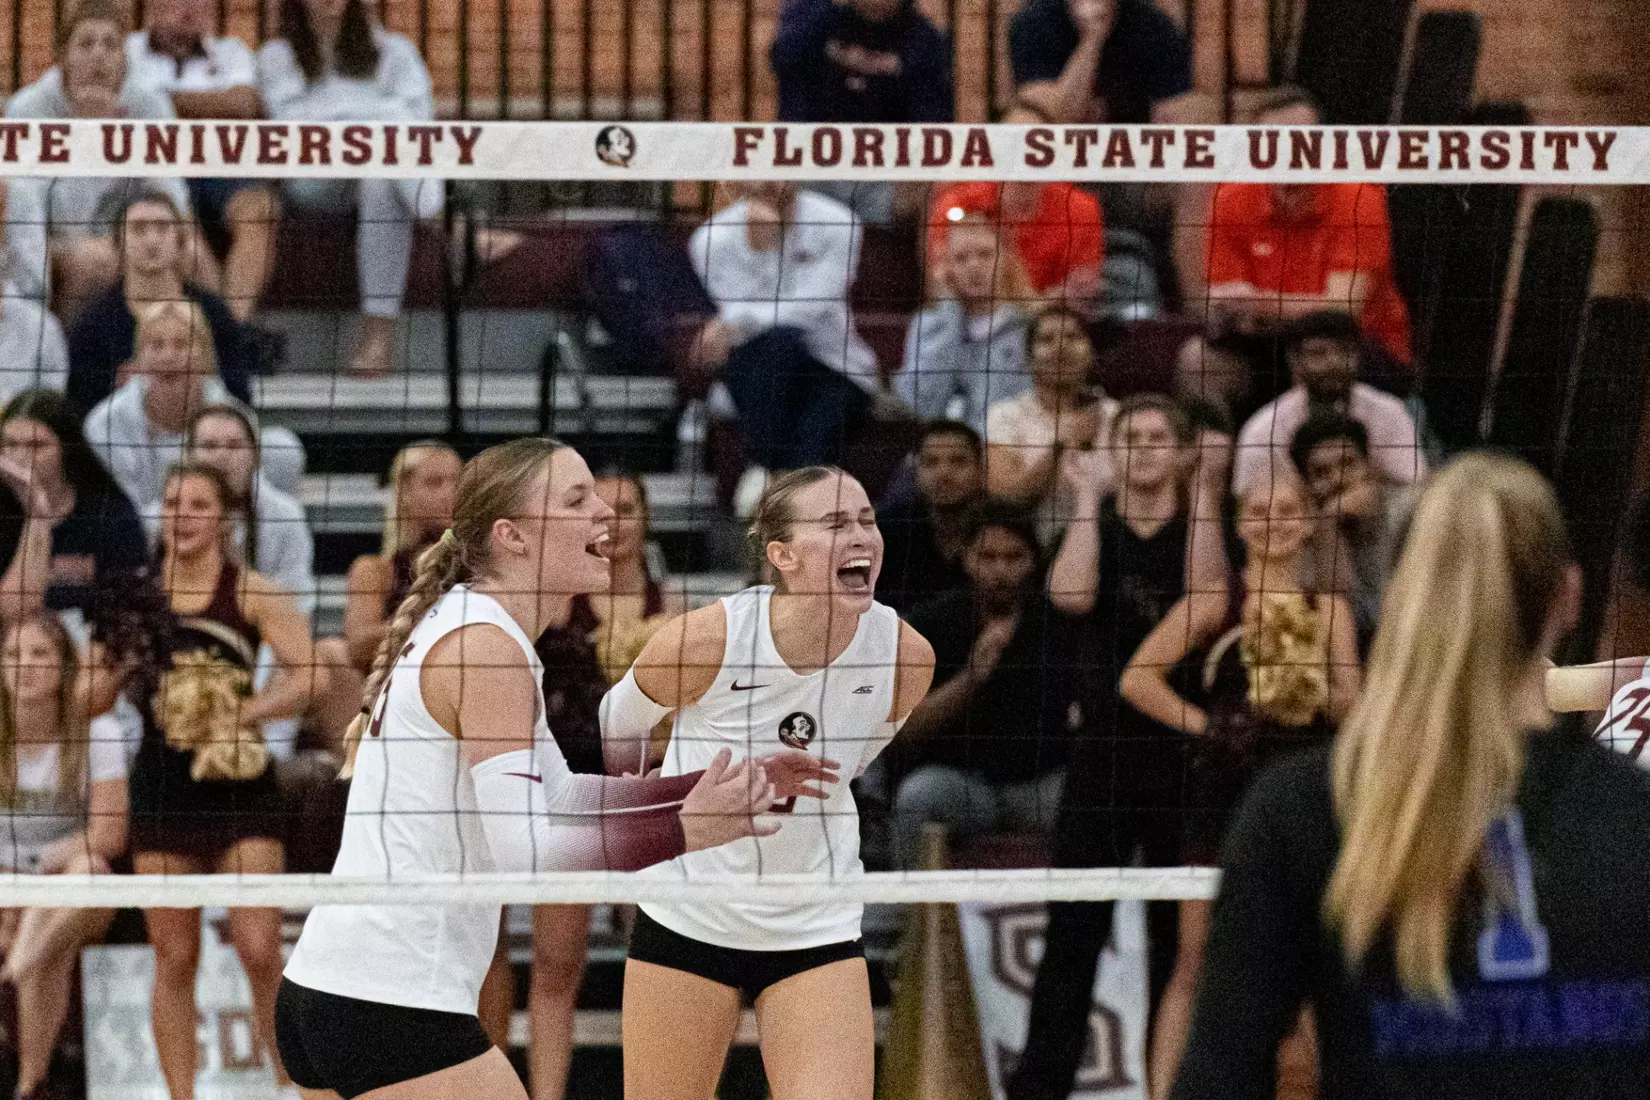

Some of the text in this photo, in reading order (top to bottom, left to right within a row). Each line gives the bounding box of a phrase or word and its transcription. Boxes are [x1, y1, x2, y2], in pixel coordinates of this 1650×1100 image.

[101, 123, 483, 165] UNIVERSITY
[732, 127, 1618, 171] FLORIDA STATE UNIVERSITY
